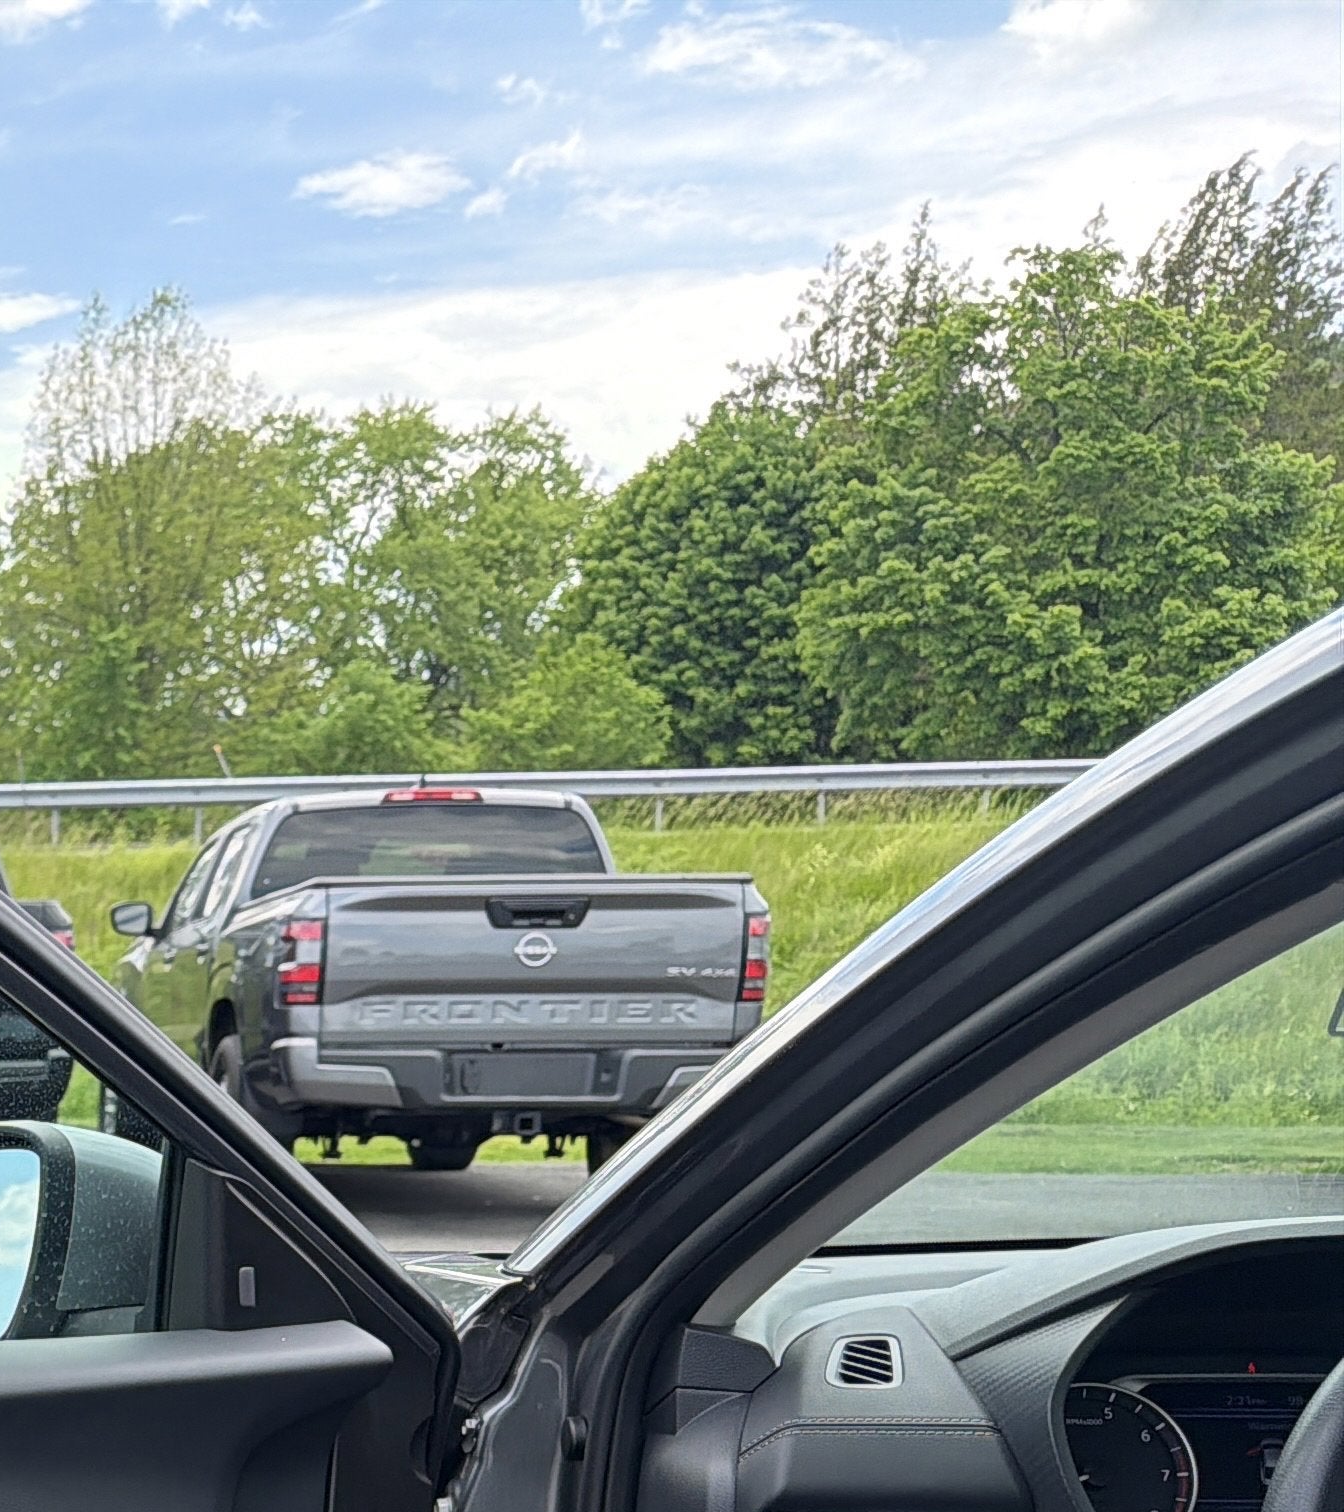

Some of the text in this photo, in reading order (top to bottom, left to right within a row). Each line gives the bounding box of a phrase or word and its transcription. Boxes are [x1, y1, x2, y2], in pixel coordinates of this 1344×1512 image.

[357, 1001, 699, 1026] FRONTIER
[1103, 1407, 1113, 1420] 5
[1140, 1429, 1151, 1443] 6
[1160, 1469, 1170, 1482] 7
